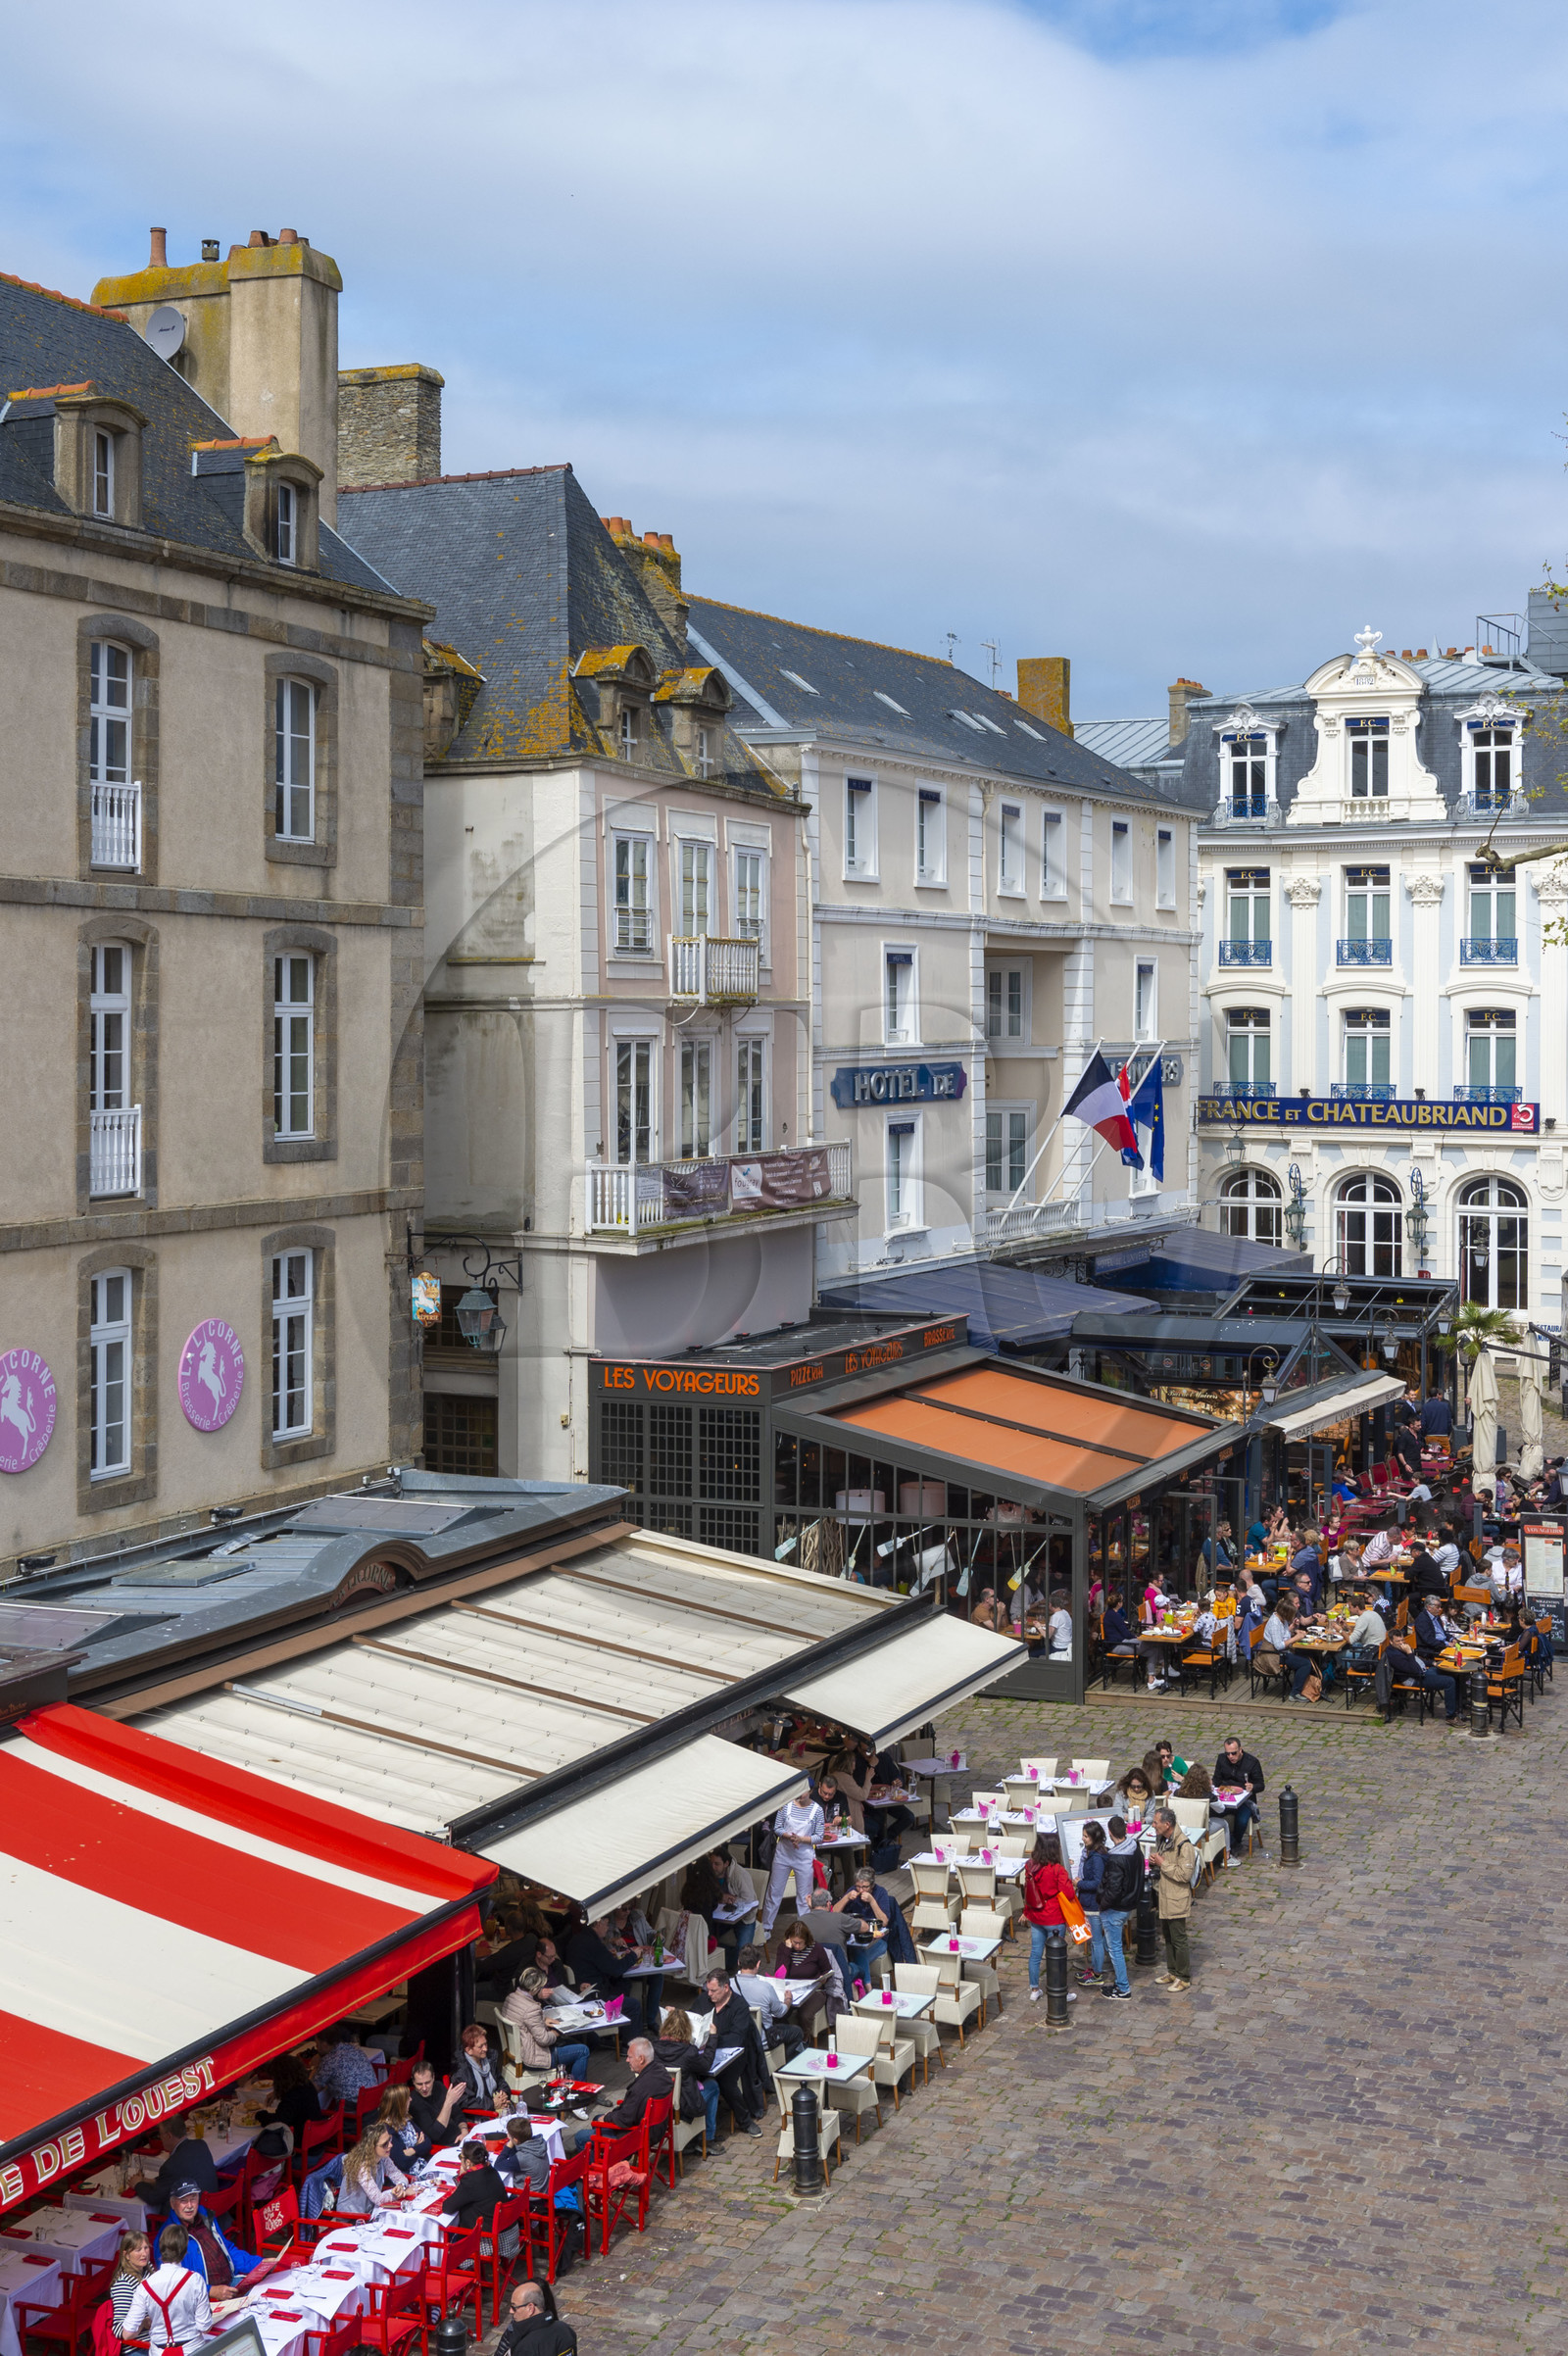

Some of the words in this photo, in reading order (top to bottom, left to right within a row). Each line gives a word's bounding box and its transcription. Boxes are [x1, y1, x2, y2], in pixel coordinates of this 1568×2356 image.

[854, 1069, 924, 1102] HOTEL
[933, 1073, 955, 1096] DE
[1199, 1100, 1280, 1121] FRANCE
[1285, 1108, 1300, 1121] ET
[1307, 1102, 1507, 1127] CHATEAUBRIAND
[923, 1328, 956, 1348] BRASSERIE
[845, 1352, 858, 1374] LES
[860, 1341, 904, 1369] VOYAGEURS
[604, 1366, 636, 1390] LES
[642, 1368, 760, 1397] VOYAGEURS
[790, 1363, 824, 1388] PIZZERIA
[181, 1381, 212, 1430] Brasserie
[218, 1371, 244, 1426] Crêperie
[1335, 1401, 1371, 1423] L'UNIVERS
[1386, 1392, 1397, 1402] BAR
[28, 1403, 56, 1462] Crêperie
[347, 1563, 393, 1592] LICORNE
[31, 2127, 85, 2184] DE
[95, 2055, 216, 2149] L'OUEST
